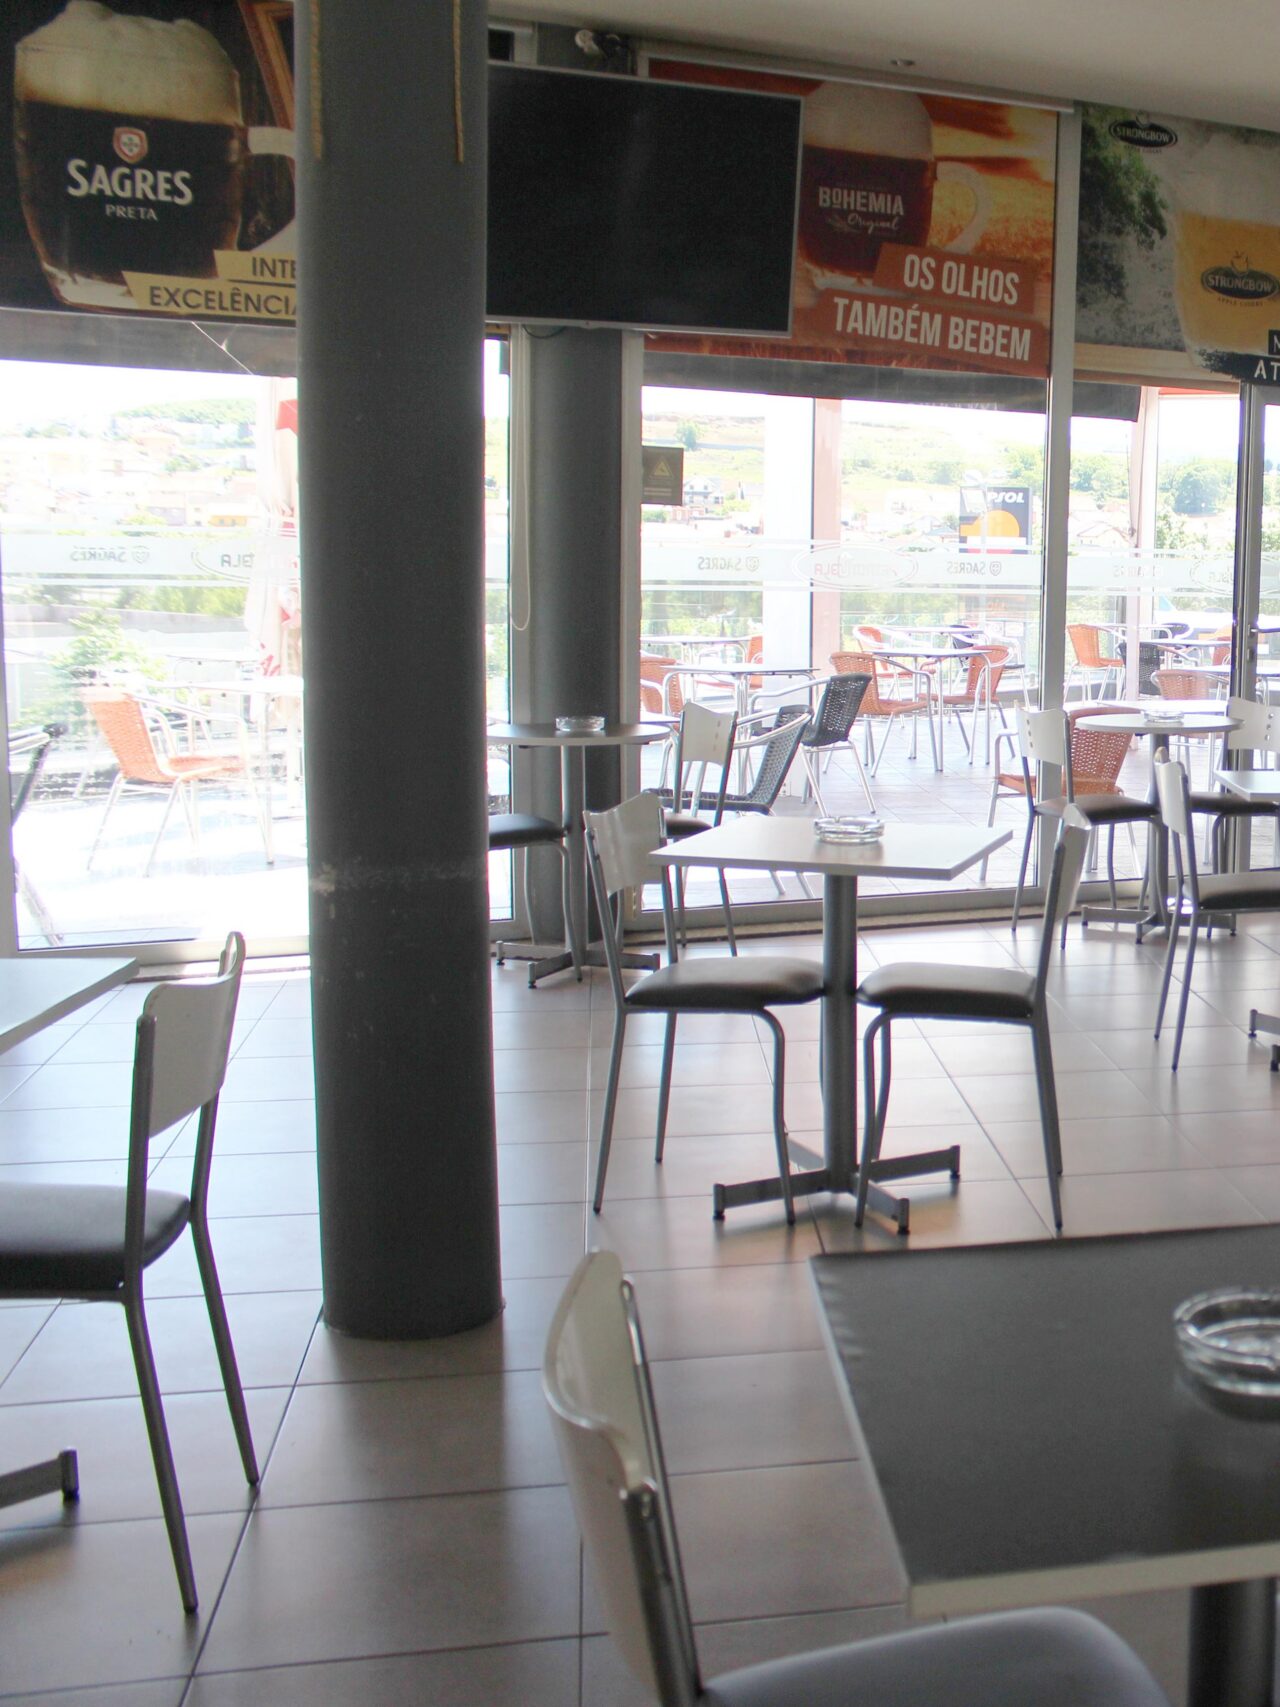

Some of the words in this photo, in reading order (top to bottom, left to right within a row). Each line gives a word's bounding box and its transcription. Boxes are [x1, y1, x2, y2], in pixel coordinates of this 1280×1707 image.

[67, 158, 193, 205] SAGRES
[105, 203, 158, 221] PRETA
[818, 186, 904, 216] BOHEMIA
[904, 253, 936, 292] OS
[941, 260, 1020, 306] OLHOS
[1207, 274, 1275, 294] STRONGBOW
[833, 296, 942, 348] TAMBÉM
[948, 316, 1032, 362] BEBEM
[1254, 359, 1267, 380] A
